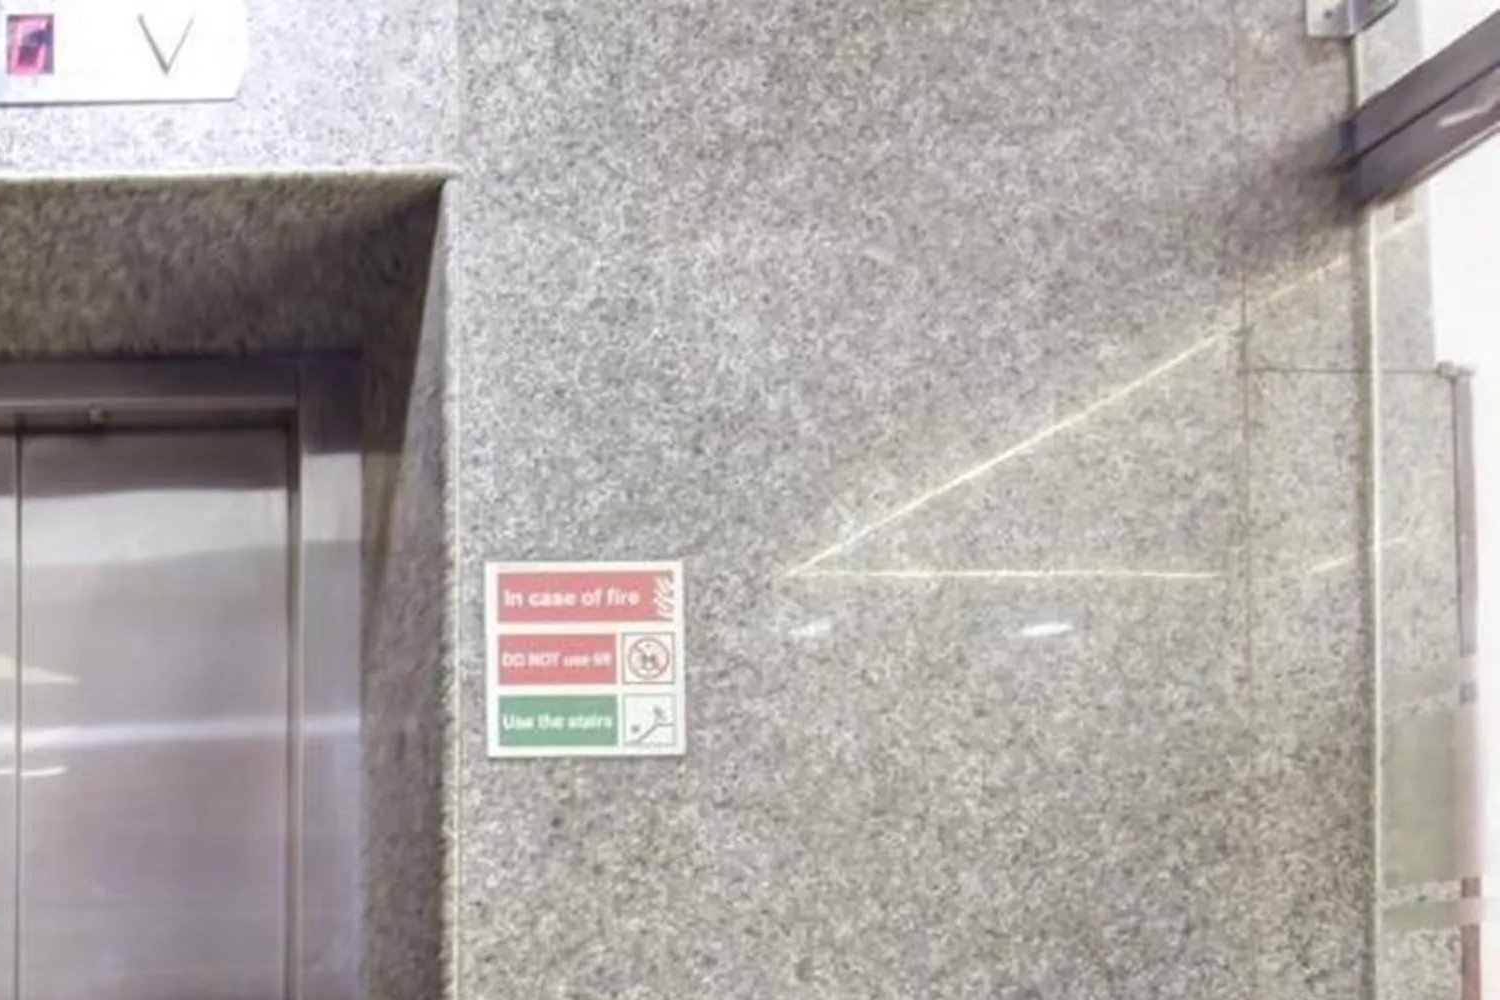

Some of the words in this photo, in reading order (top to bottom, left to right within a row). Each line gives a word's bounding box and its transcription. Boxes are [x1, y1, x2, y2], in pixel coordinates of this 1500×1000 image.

[504, 590, 523, 608] In
[528, 592, 576, 607] case
[581, 588, 601, 607] of
[607, 587, 640, 606] fire
[502, 652, 525, 667] DO
[528, 652, 560, 667] NOT
[563, 655, 589, 667] use
[502, 713, 533, 730] Use
[538, 713, 563, 729] the
[567, 713, 612, 729] stairs
